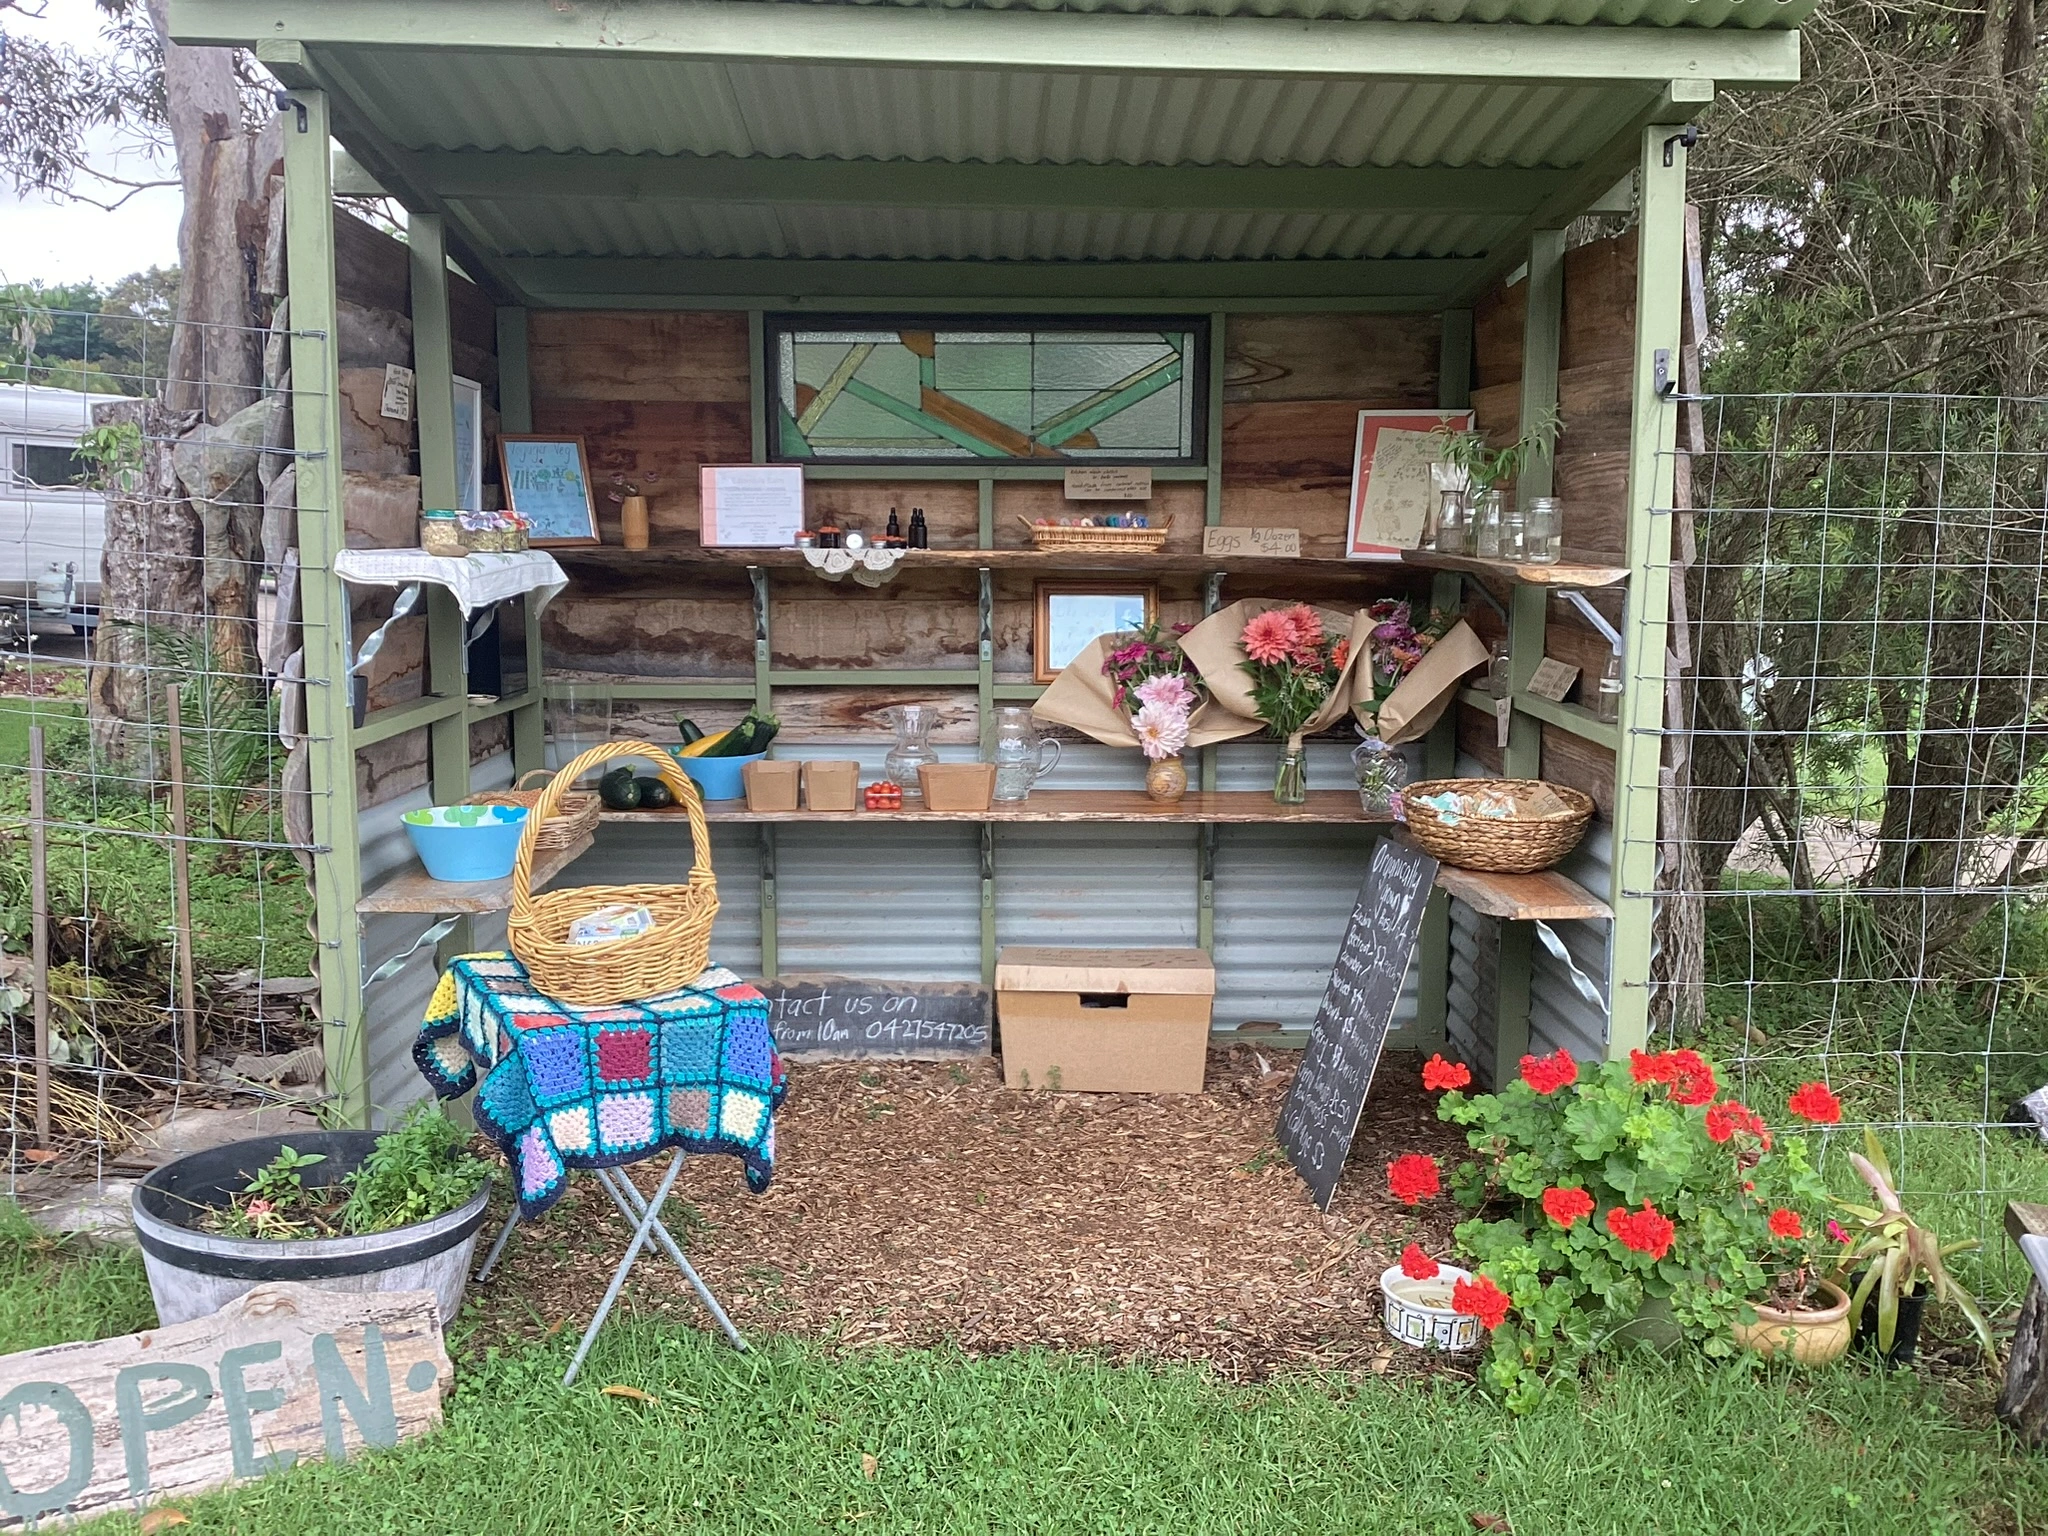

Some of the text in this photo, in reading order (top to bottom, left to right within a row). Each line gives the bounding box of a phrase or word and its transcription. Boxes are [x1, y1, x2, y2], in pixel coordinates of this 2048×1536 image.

[1207, 529, 1241, 552] Eggs
[1263, 528, 1296, 541] Dozen
[1372, 843, 1423, 900] Organically
[844, 995, 874, 1014] us
[881, 995, 918, 1014] on
[772, 1018, 989, 1044] from 10am 0427547205
